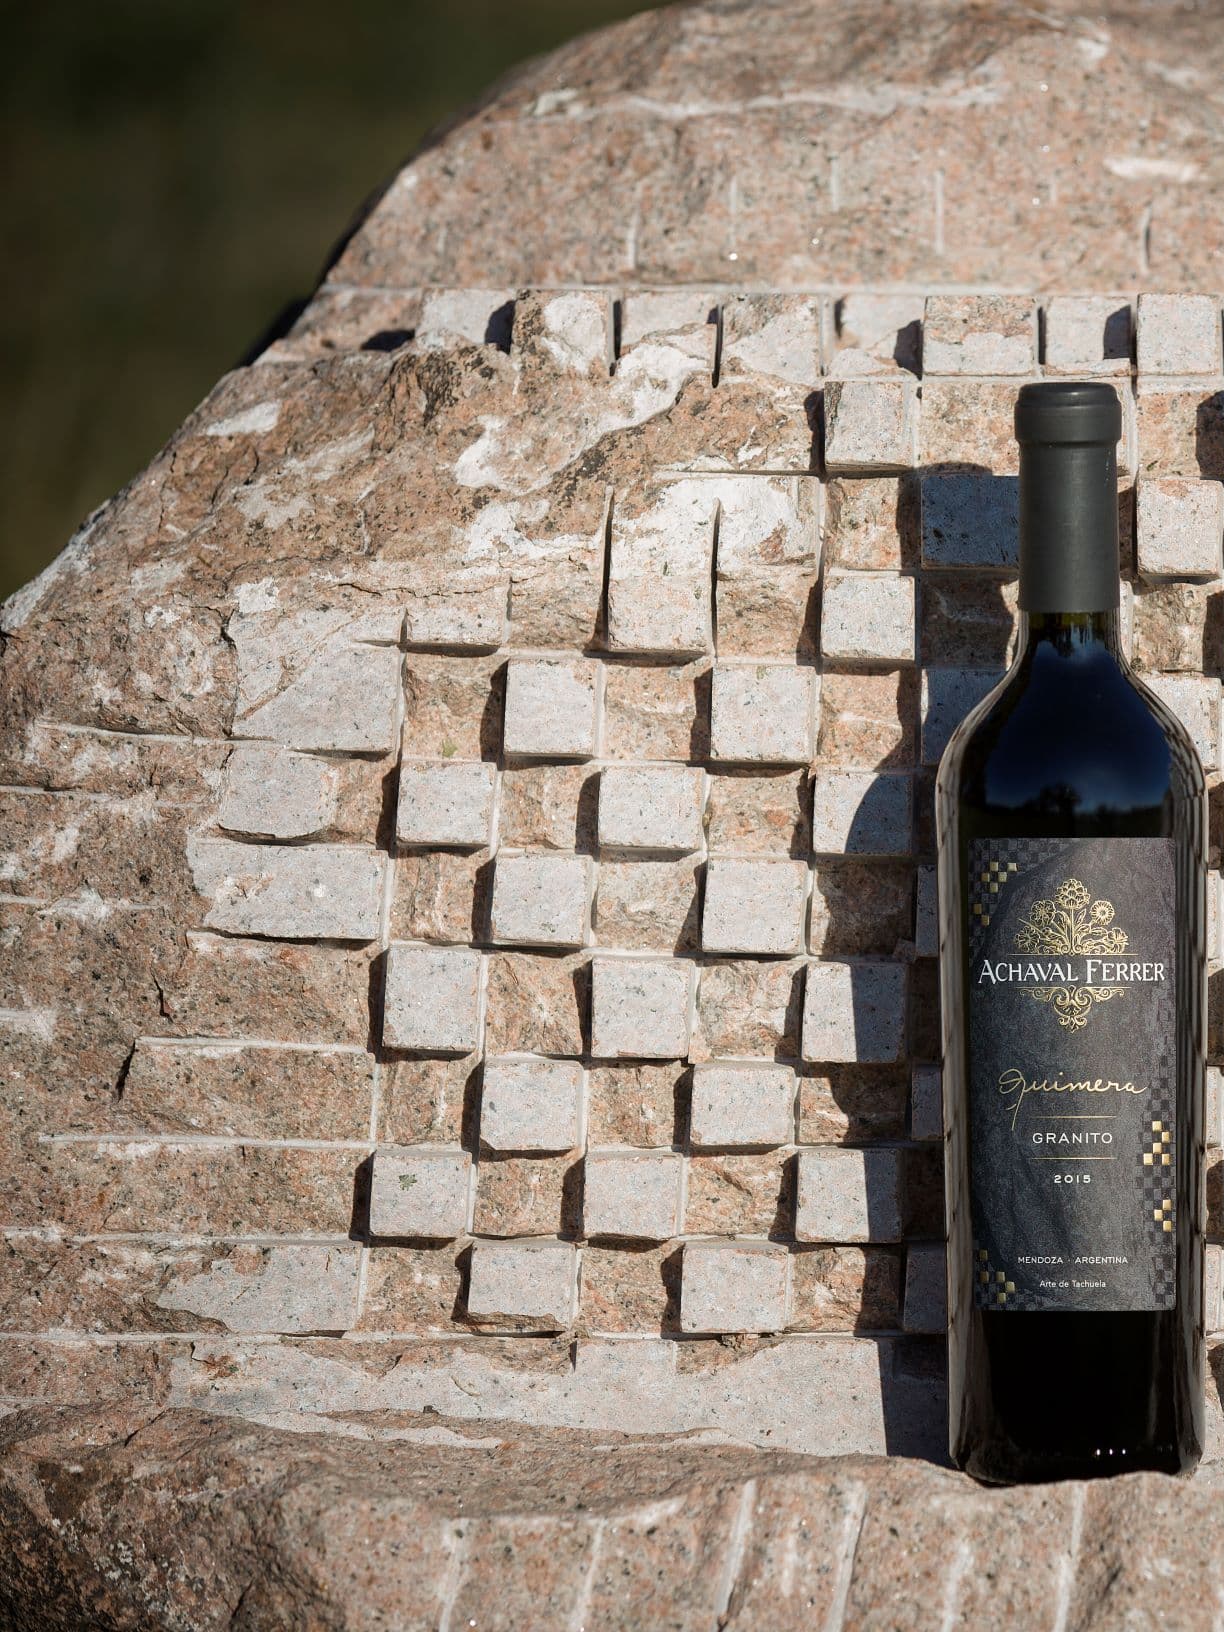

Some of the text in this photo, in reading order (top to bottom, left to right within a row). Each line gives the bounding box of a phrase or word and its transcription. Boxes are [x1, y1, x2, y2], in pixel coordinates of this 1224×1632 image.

[978, 959, 1165, 984] ACHAVAL FERRER
[1032, 1132, 1113, 1144] GRANITO
[1053, 1174, 1092, 1184] 2015
[1017, 1256, 1128, 1264] MENDOZA ARGENTINA
[1058, 1279, 1070, 1288] de
